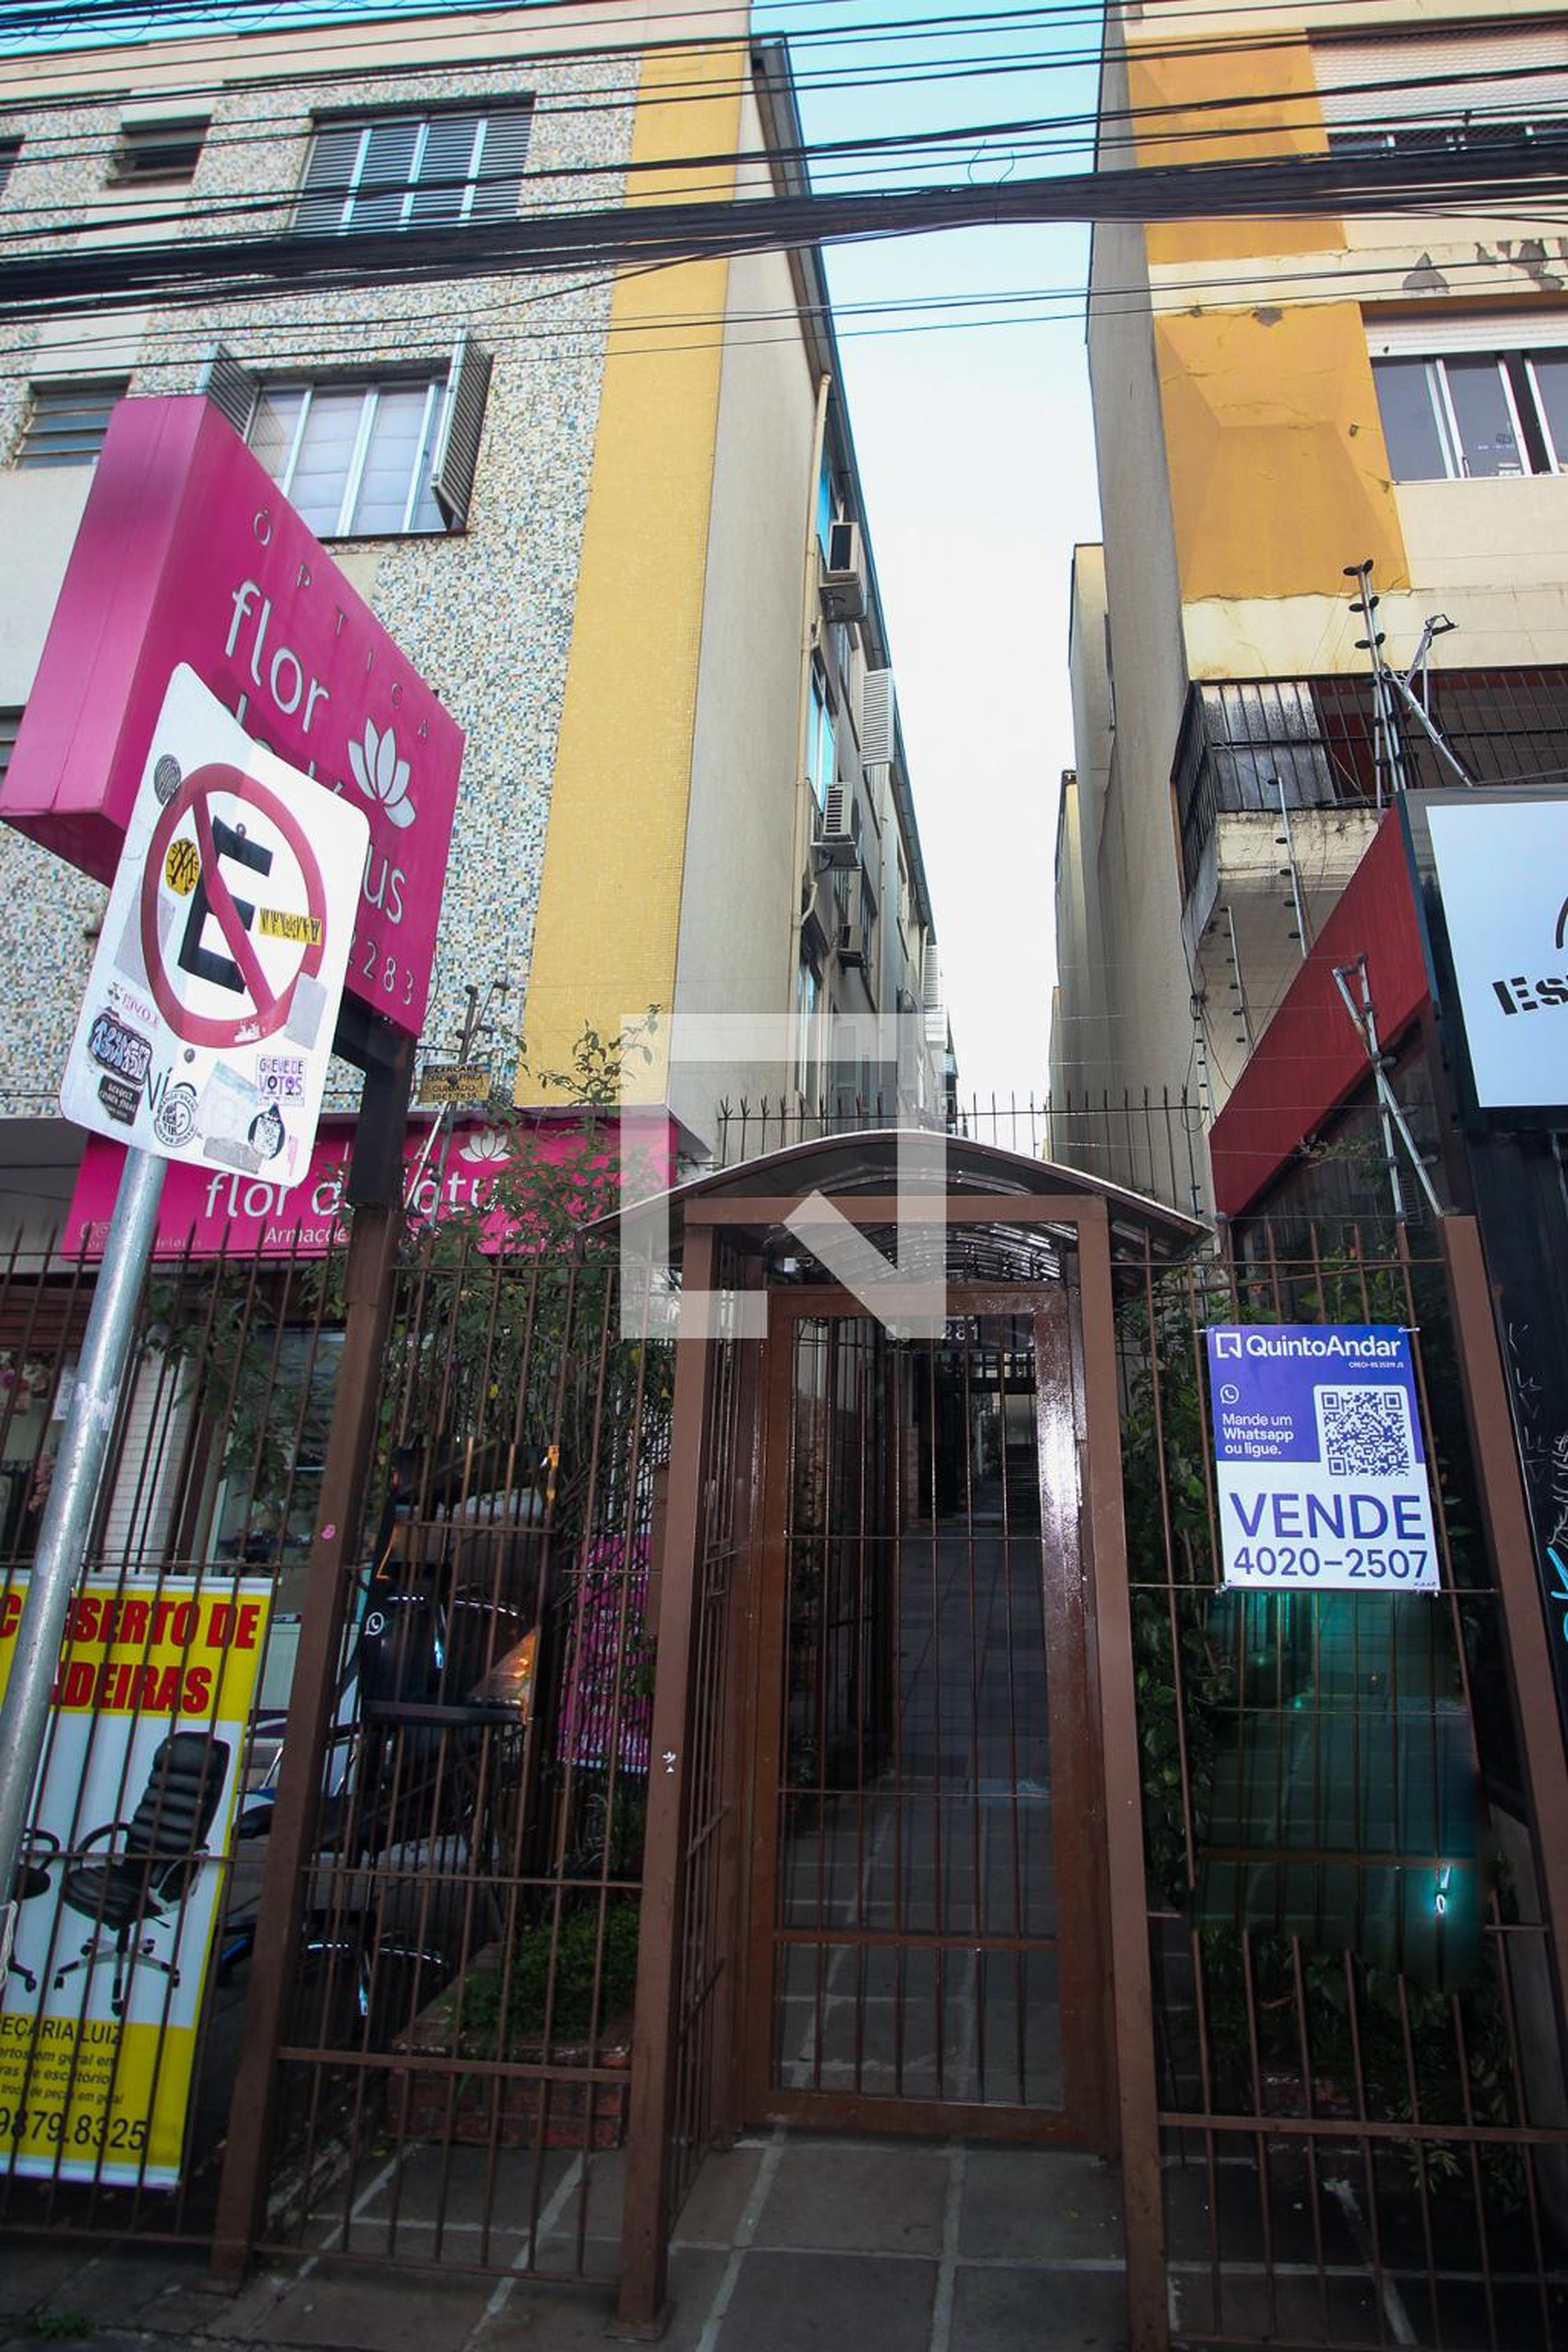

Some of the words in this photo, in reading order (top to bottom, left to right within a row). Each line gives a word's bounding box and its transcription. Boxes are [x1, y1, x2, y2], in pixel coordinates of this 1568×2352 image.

[225, 580, 329, 734] flor
[205, 1172, 292, 1218] flor
[1246, 1335, 1401, 1357] QuintoAndar
[1223, 1413, 1269, 1426] Mande
[1271, 1415, 1292, 1426] um
[1223, 1428, 1294, 1443] Whatsapp
[1225, 1444, 1242, 1454] ou
[1244, 1442, 1282, 1458] ligue.
[1229, 1492, 1425, 1540] VENDE
[1234, 1546, 1428, 1579] 4020-2507
[206, 1603, 261, 1649] DE
